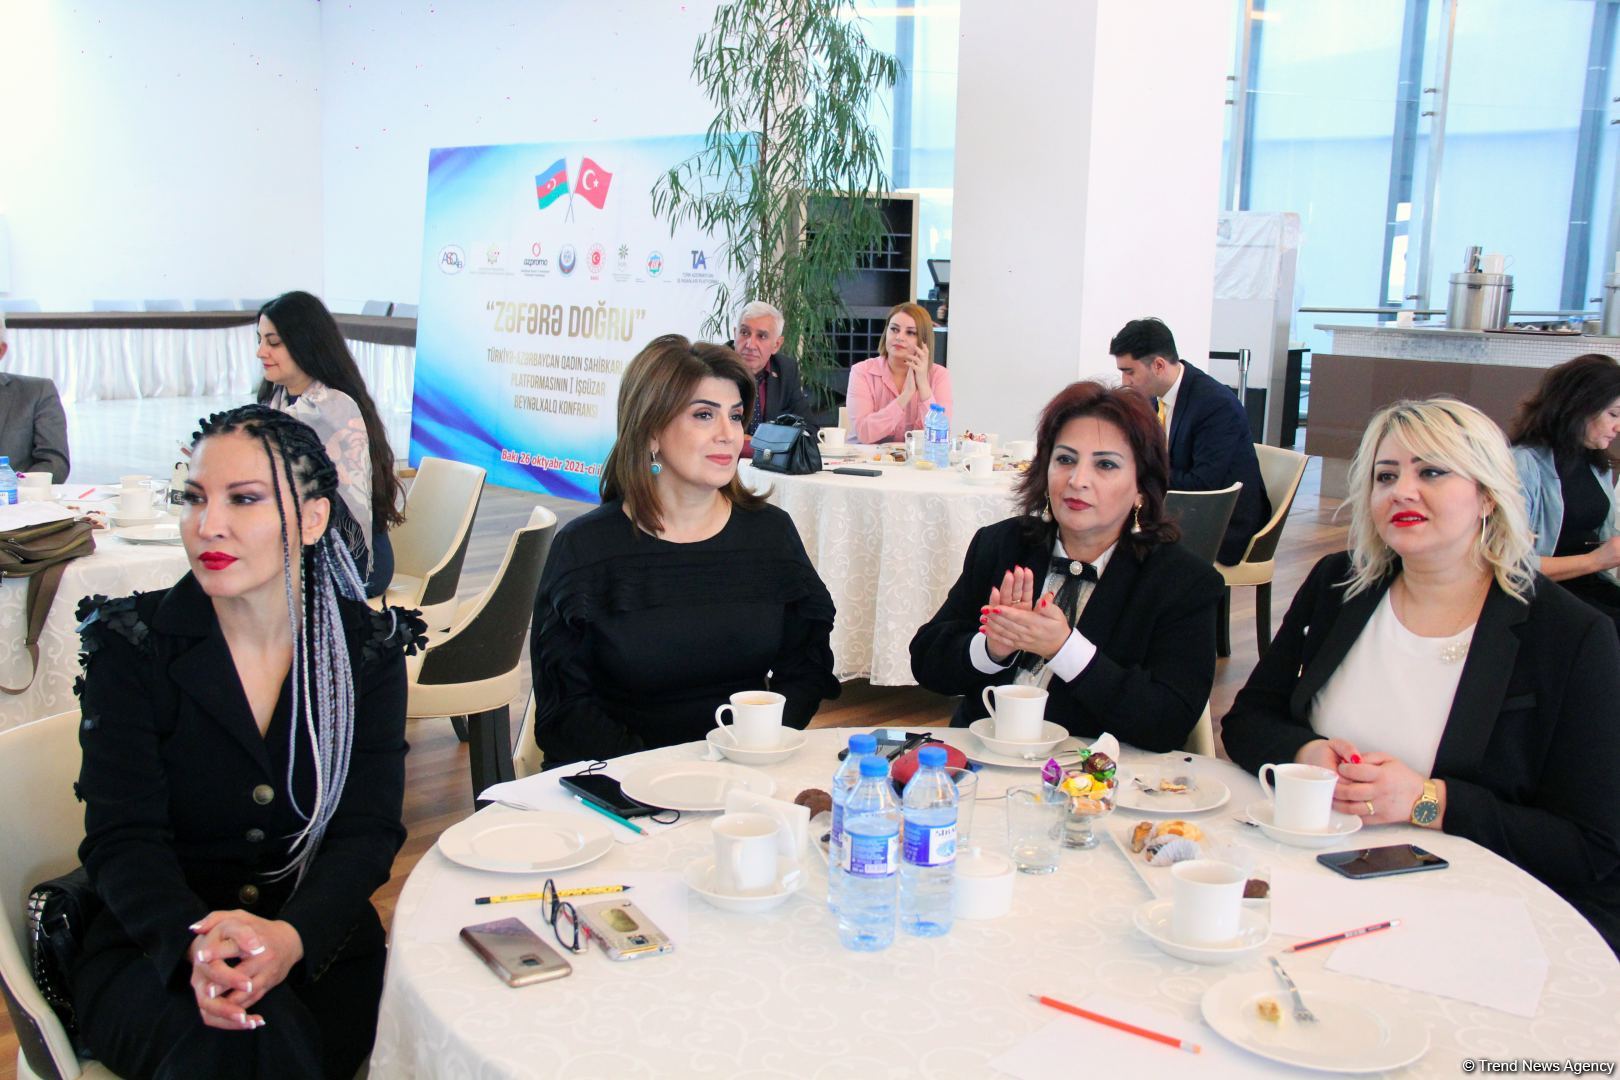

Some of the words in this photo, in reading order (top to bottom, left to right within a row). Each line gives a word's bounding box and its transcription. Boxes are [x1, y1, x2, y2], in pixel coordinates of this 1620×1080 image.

[523, 258, 548, 267] azpromo
[691, 250, 707, 269] TA
[568, 300, 646, 342] DOĞRU”
[561, 355, 582, 372] QADIN
[511, 372, 568, 393] PLATFORMASININ
[575, 376, 606, 397] İŞGÜZAR
[514, 394, 557, 414] BEYNƏLXALQ
[519, 452, 530, 464] 26
[531, 455, 562, 470] oktyabr
[564, 460, 595, 475] 2021-ci
